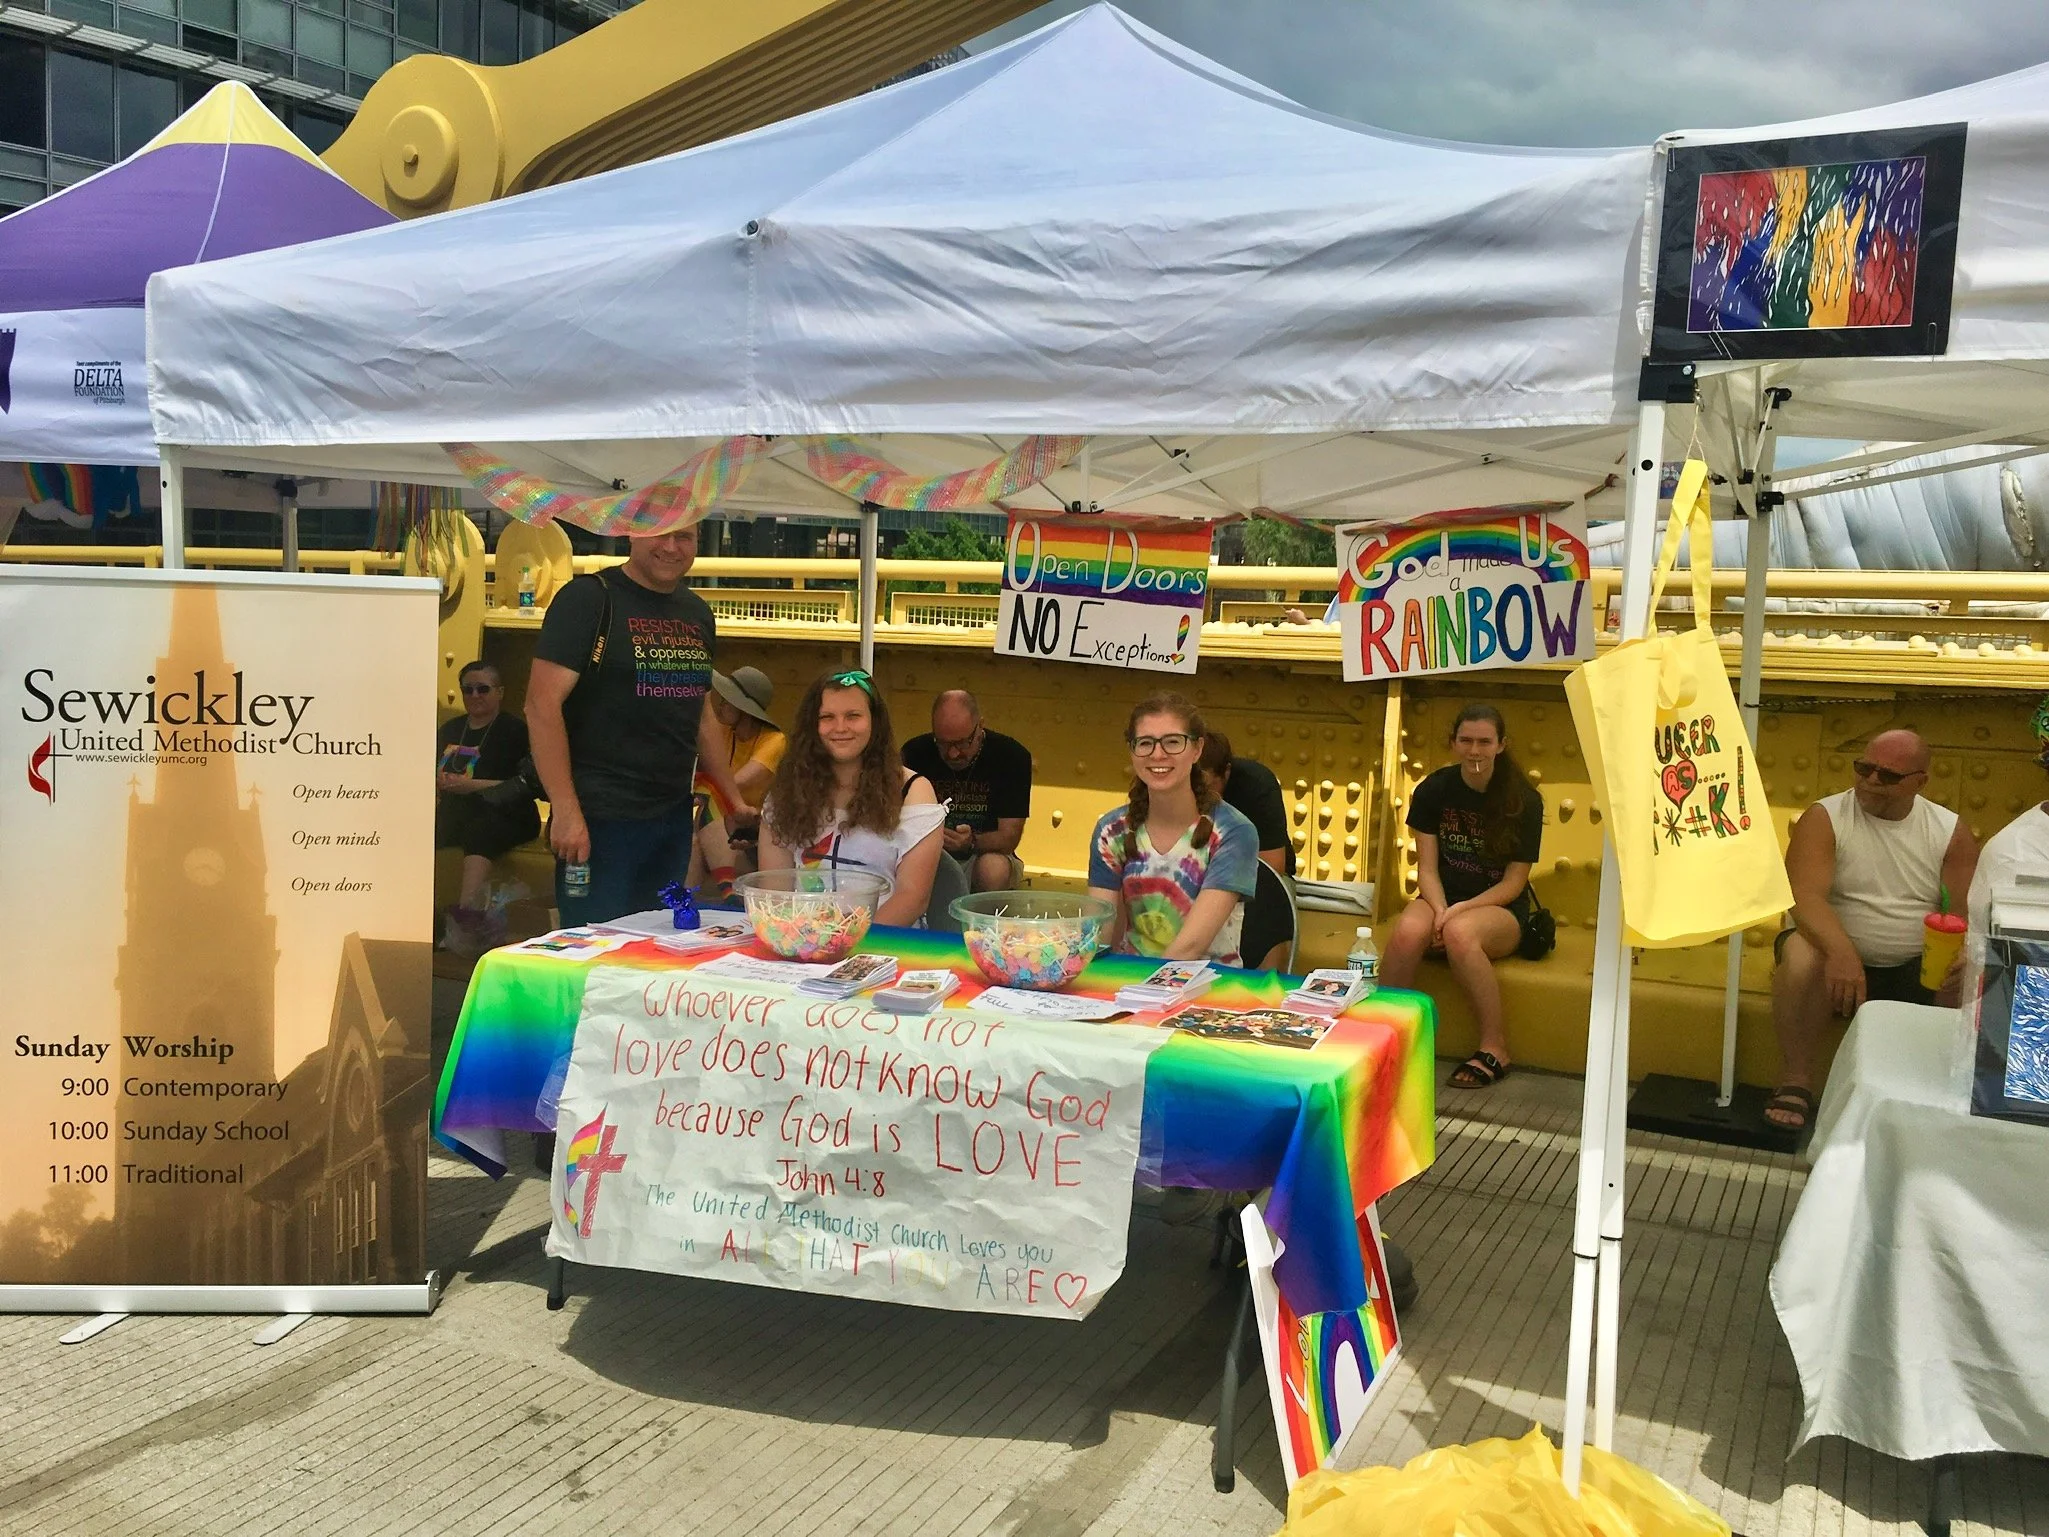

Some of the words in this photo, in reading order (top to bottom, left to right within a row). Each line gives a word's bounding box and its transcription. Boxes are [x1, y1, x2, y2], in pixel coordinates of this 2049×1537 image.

[74, 368, 123, 387] DELTA
[74, 386, 125, 397] FOUNDATION
[1008, 520, 1088, 593] Open
[1101, 528, 1206, 594] Doors
[1347, 533, 1450, 589] God
[1518, 513, 1575, 569] Us
[1449, 577, 1461, 592] a
[1008, 594, 1061, 655] NO
[1361, 580, 1586, 676] RAINBOW
[592, 635, 606, 663] Nikon
[634, 645, 646, 658] &
[636, 660, 647, 670] in
[649, 660, 690, 671] whatever
[637, 669, 668, 686] they
[21, 668, 315, 745] Sewickley
[60, 727, 145, 752] United
[153, 729, 278, 754] Methodist
[292, 732, 383, 756] Church
[75, 753, 208, 767] www.sewickleyumc.org
[292, 783, 332, 802] Open
[336, 783, 380, 800] hearts
[291, 830, 332, 848] Open
[336, 830, 381, 847] minds
[291, 877, 330, 895] Open
[334, 876, 373, 892] doors
[643, 979, 786, 1027] Whoever
[923, 1016, 1006, 1048] not
[14, 1034, 111, 1064] Sunday
[123, 1034, 234, 1065] Worship
[61, 1078, 109, 1097] 9:00
[123, 1077, 289, 1101] Contemporary
[612, 1025, 692, 1076] love
[701, 1021, 789, 1083] does
[804, 1043, 870, 1091] not
[878, 1051, 1001, 1110] Know
[1026, 1071, 1111, 1132] God
[48, 1120, 109, 1141] 10:00
[123, 1120, 207, 1146] Sunday
[214, 1120, 289, 1142] School
[654, 1089, 764, 1139] because
[781, 1096, 850, 1147] God
[873, 1116, 901, 1154] is
[934, 1114, 1082, 1188] LOVE
[48, 1164, 108, 1184] 11:00
[122, 1163, 244, 1185] Traditional
[776, 1159, 837, 1197] John
[844, 1165, 886, 1198] 4:8
[645, 1183, 675, 1206] The
[693, 1190, 769, 1222] United
[776, 1200, 881, 1243] Methodist
[891, 1223, 949, 1254] Church
[960, 1232, 1007, 1260] Loves
[1017, 1243, 1054, 1270] you
[679, 1235, 695, 1254] in
[888, 1248, 951, 1293] YOU
[976, 1263, 1044, 1304] ARE
